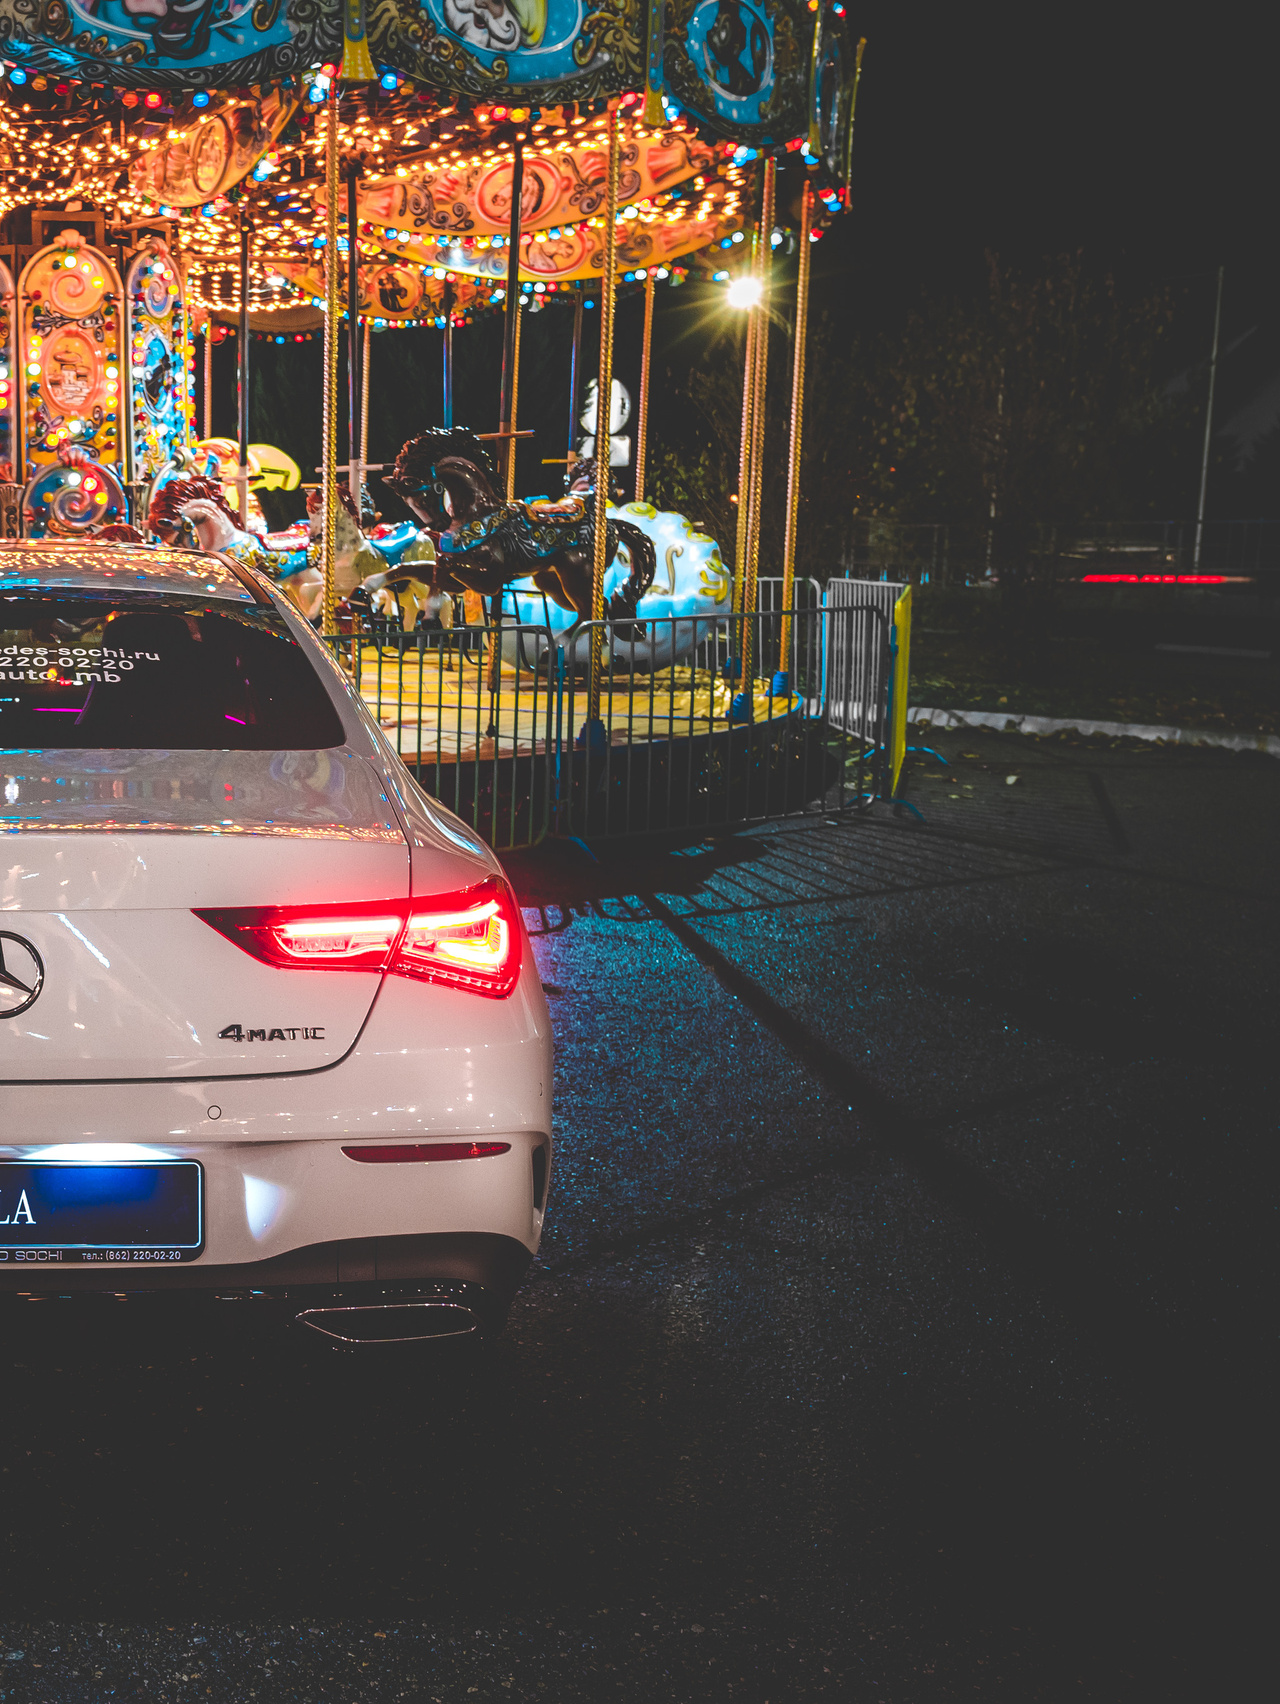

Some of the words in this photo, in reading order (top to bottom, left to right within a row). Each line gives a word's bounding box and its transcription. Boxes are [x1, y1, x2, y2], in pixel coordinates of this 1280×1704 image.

[218, 1024, 325, 1042] 4MATIC
[14, 1250, 63, 1261] SOCHI
[105, 1249, 130, 1261] (862)
[133, 1250, 181, 1260] 220-02-20
